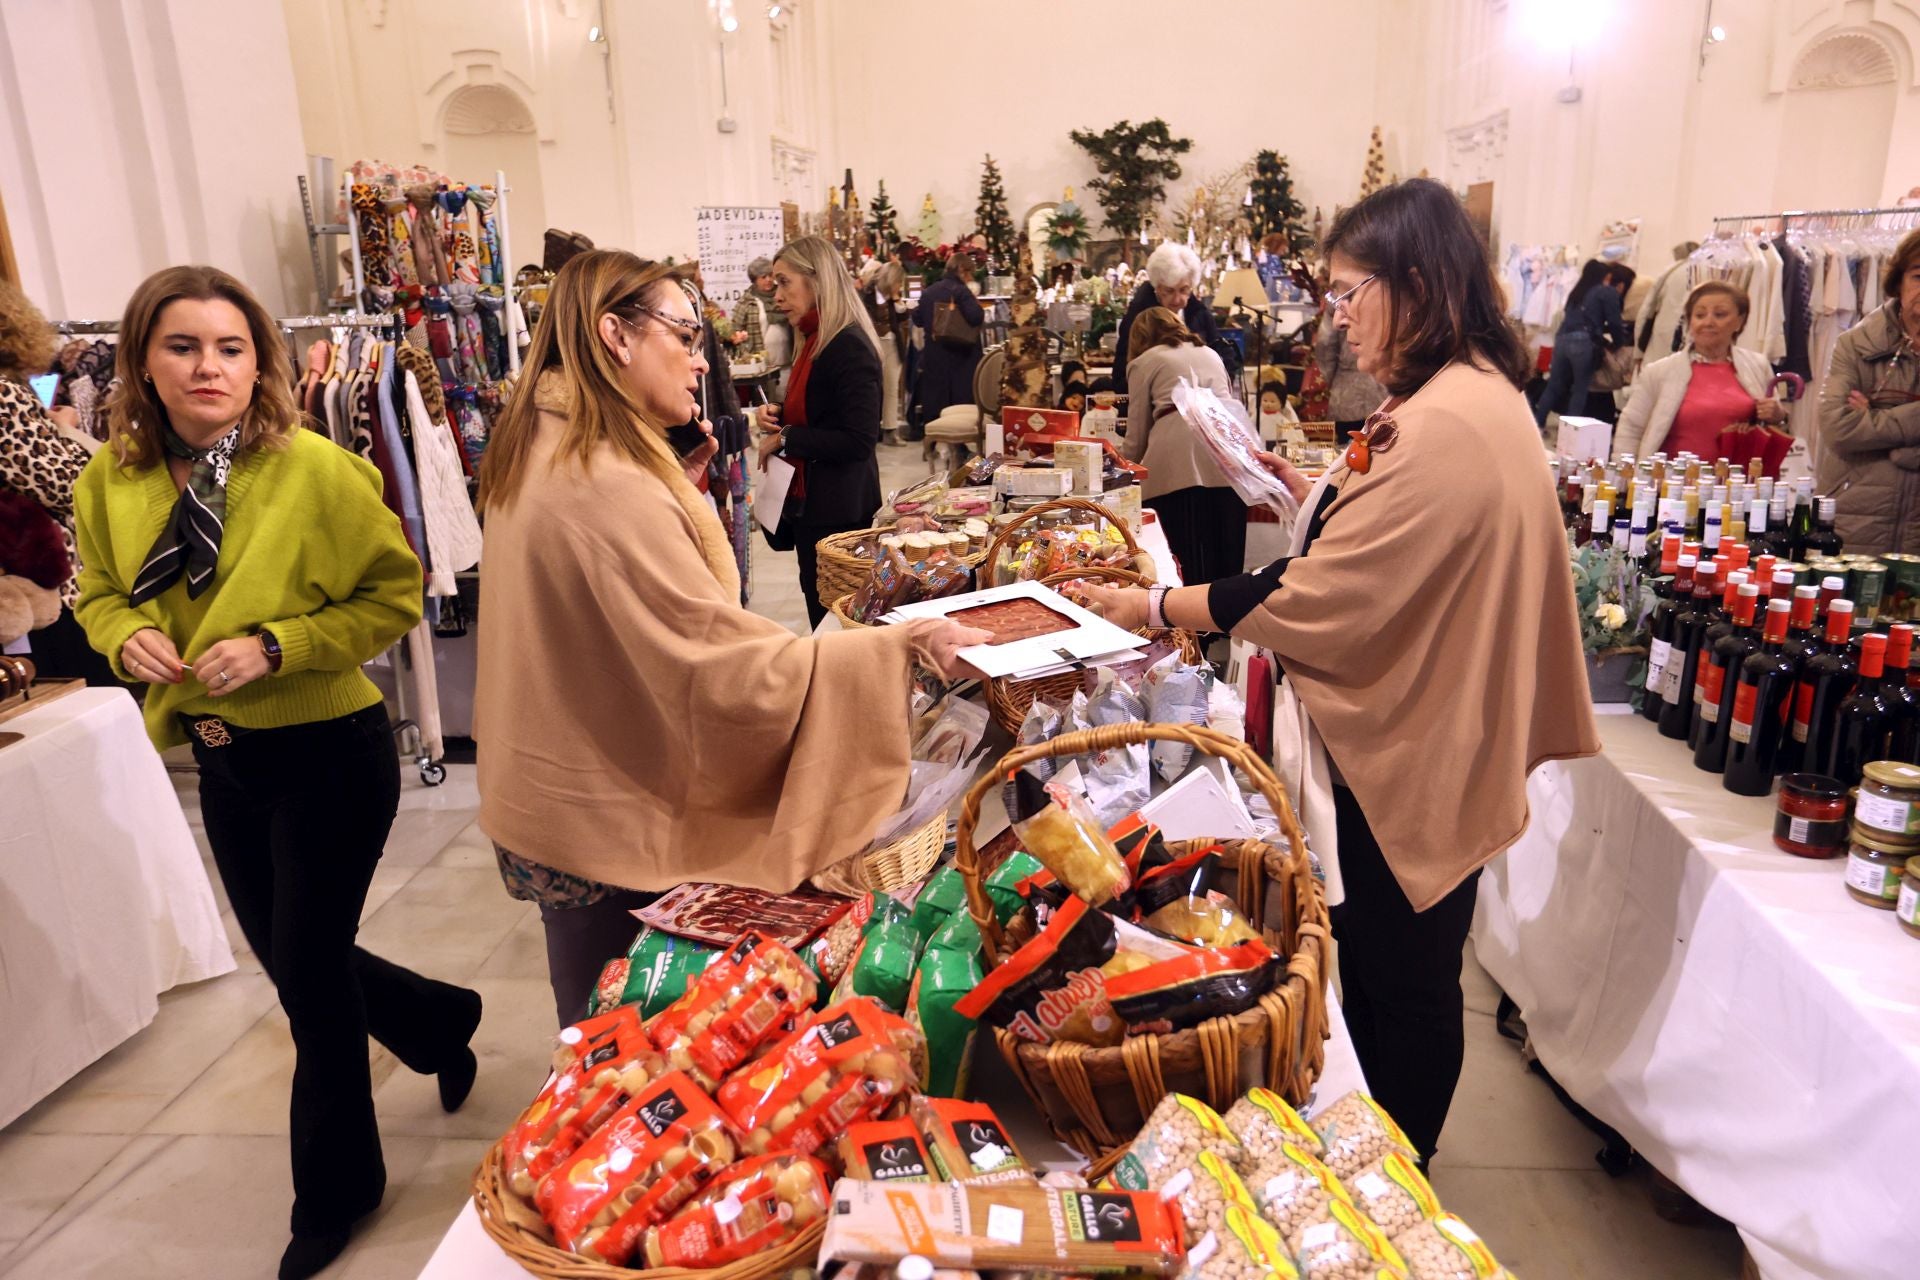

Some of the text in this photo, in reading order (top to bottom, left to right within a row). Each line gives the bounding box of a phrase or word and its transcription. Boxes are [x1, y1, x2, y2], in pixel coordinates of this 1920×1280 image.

[739, 232, 780, 240] ADEVIDA
[713, 264, 748, 273] ADEVID
[818, 1023, 836, 1048] GALLO
[1007, 1011, 1049, 1043] El
[639, 1106, 663, 1134] GALLO
[875, 1163, 924, 1178] GALLO
[1065, 1194, 1081, 1237] NATURE
[1080, 1194, 1100, 1238] GALLO
